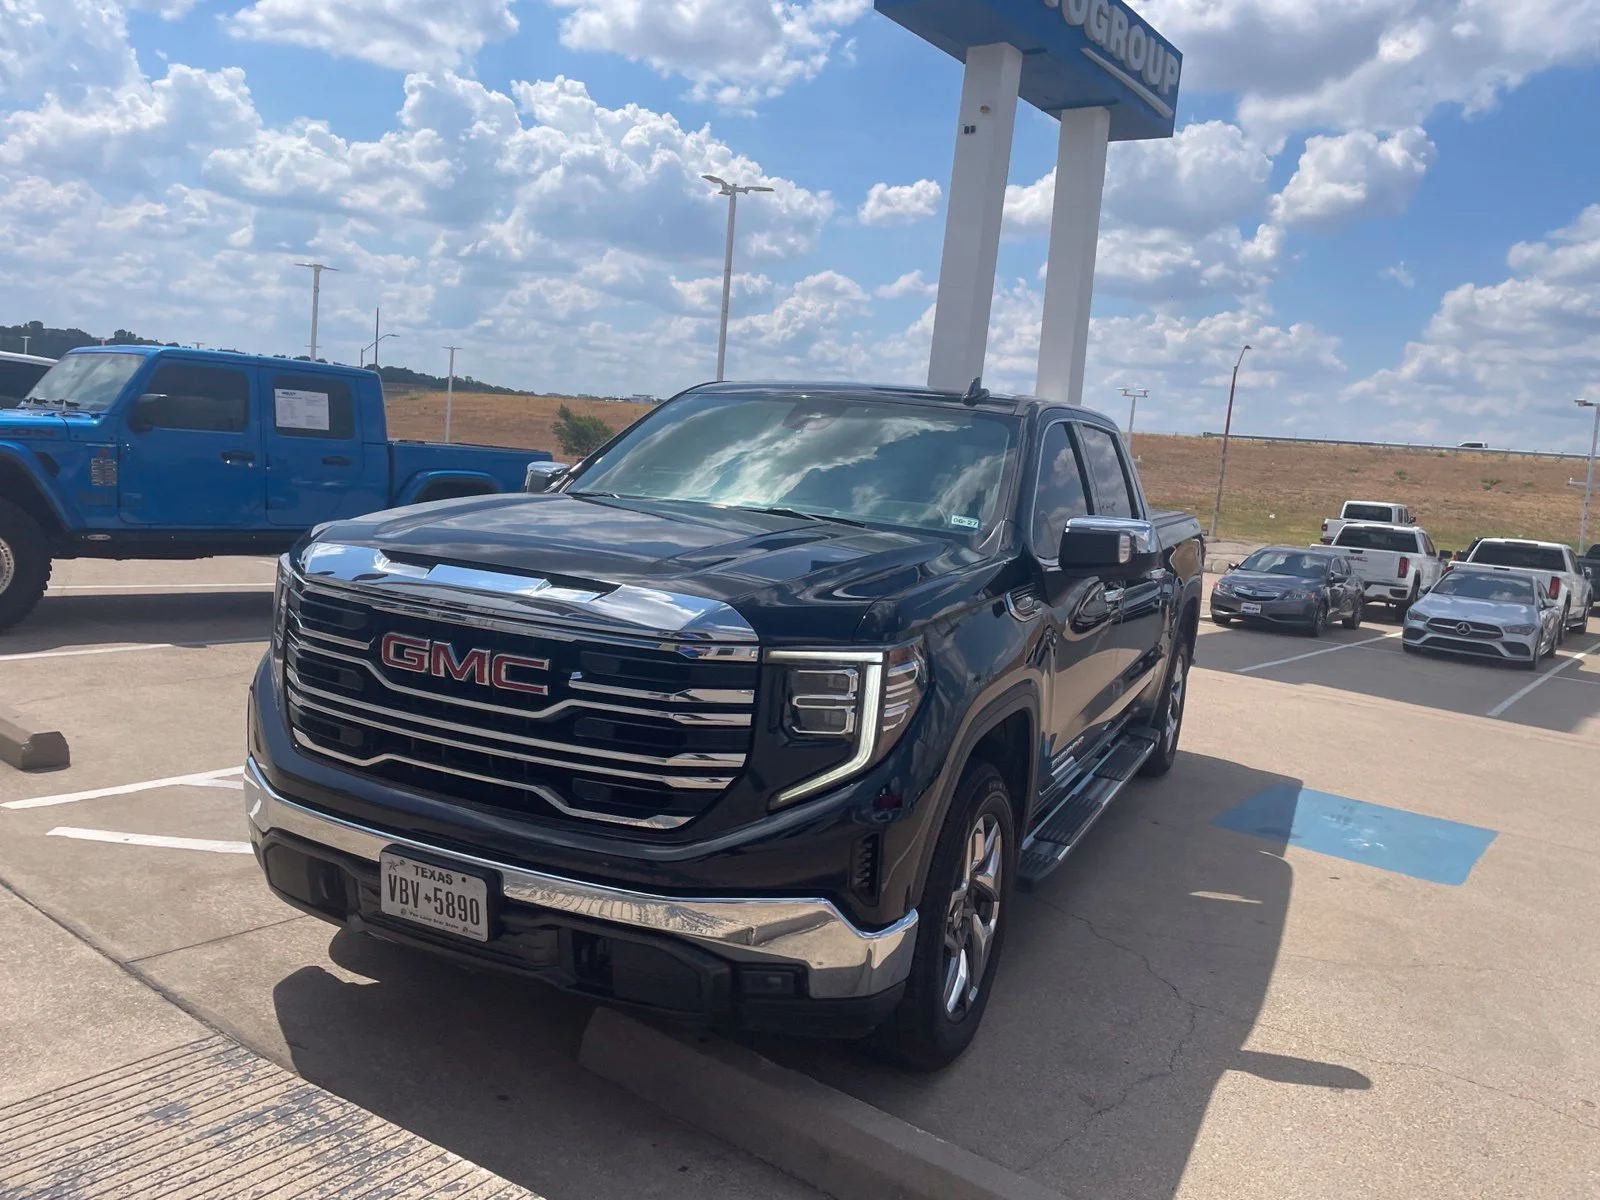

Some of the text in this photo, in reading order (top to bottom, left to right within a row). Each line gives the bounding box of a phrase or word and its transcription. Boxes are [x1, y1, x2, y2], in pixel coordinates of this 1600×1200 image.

[381, 631, 550, 696] GMC
[388, 873, 480, 926] VBV 5890
[413, 864, 453, 885] TEXAS
